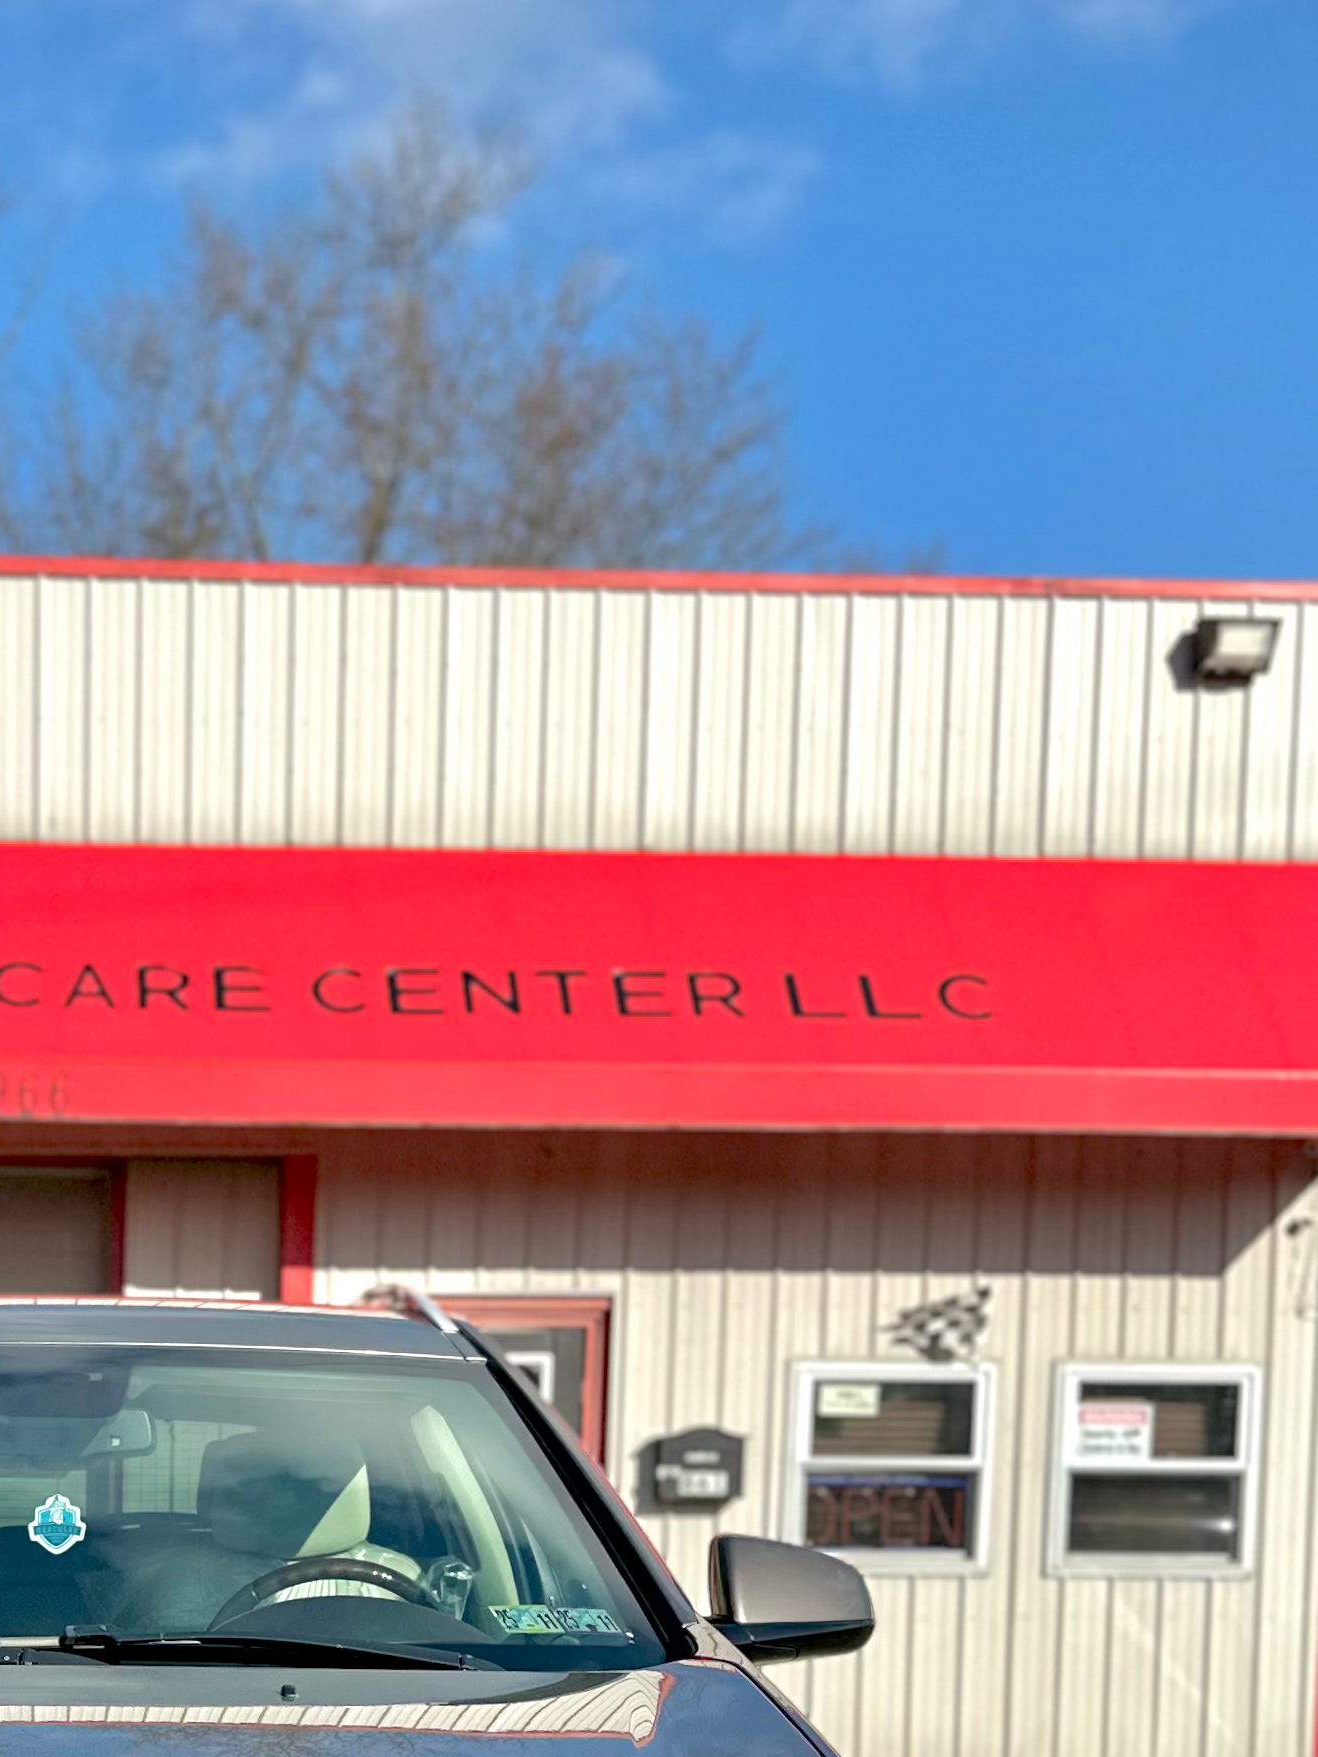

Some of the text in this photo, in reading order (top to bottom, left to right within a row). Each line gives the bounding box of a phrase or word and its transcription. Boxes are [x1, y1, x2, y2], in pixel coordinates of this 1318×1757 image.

[310, 969, 745, 1018] CENTER
[783, 972, 992, 1020] LLC
[807, 1485, 966, 1547] OPEN
[495, 1609, 559, 1630] 25 11
